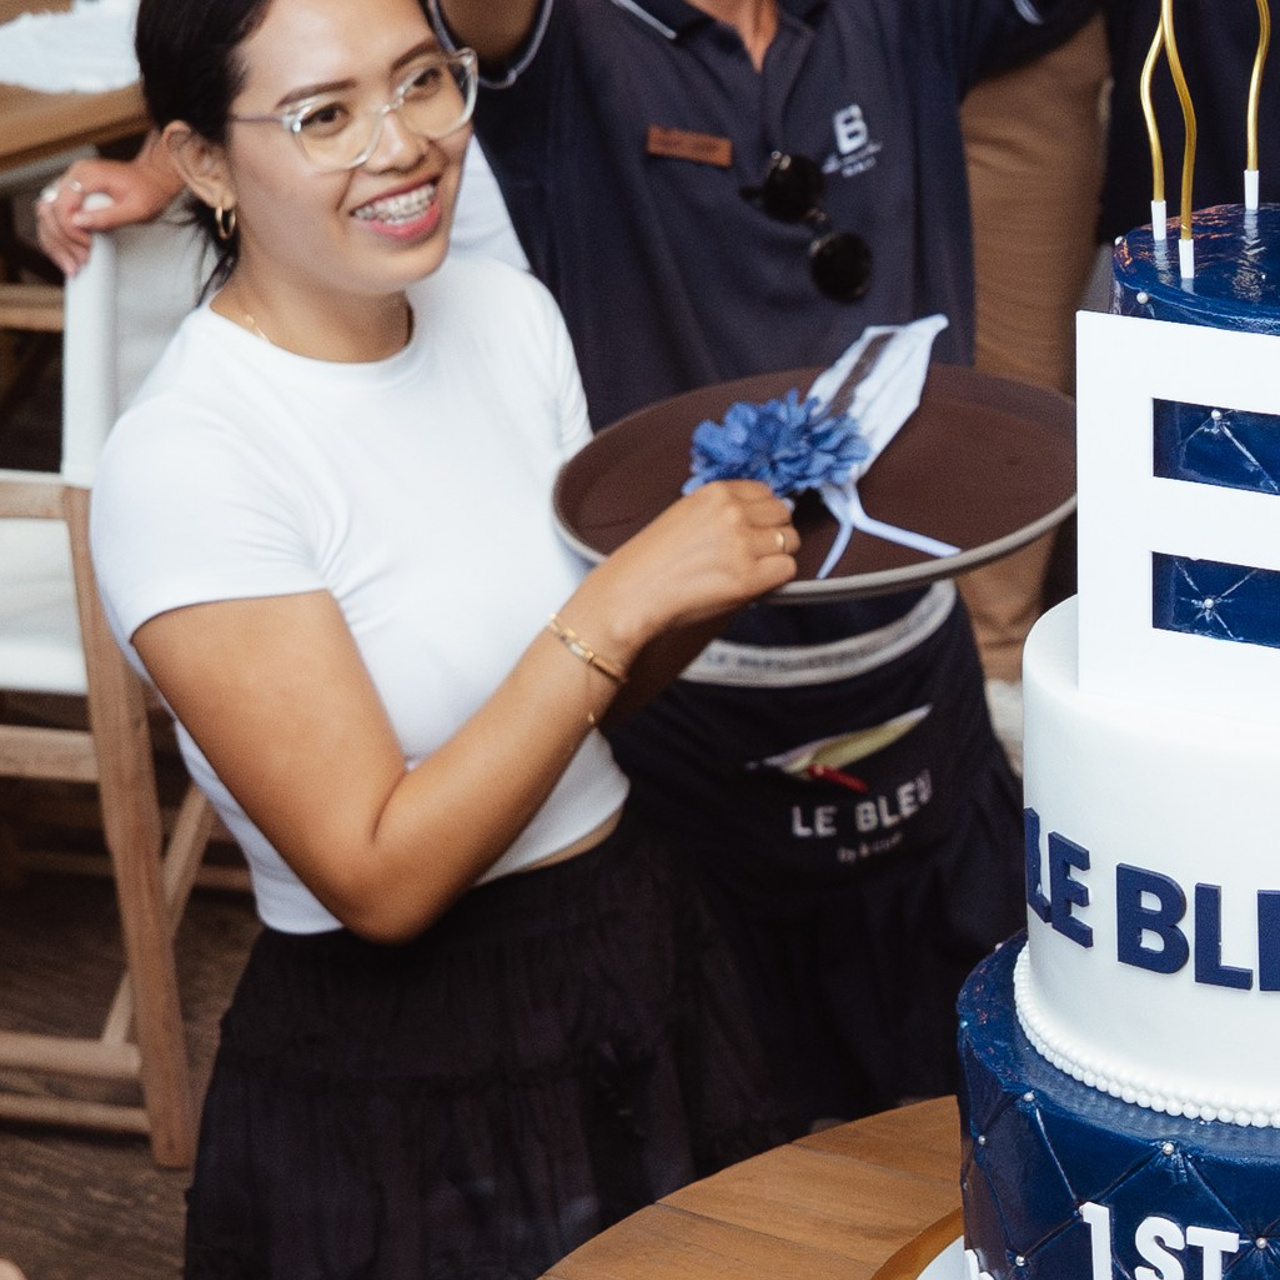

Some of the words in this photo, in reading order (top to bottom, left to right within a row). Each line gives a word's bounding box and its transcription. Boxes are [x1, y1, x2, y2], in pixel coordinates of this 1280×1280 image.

[833, 104, 868, 155] B
[790, 804, 838, 838] LE
[854, 769, 934, 833] BLEU
[1023, 806, 1094, 949] LE
